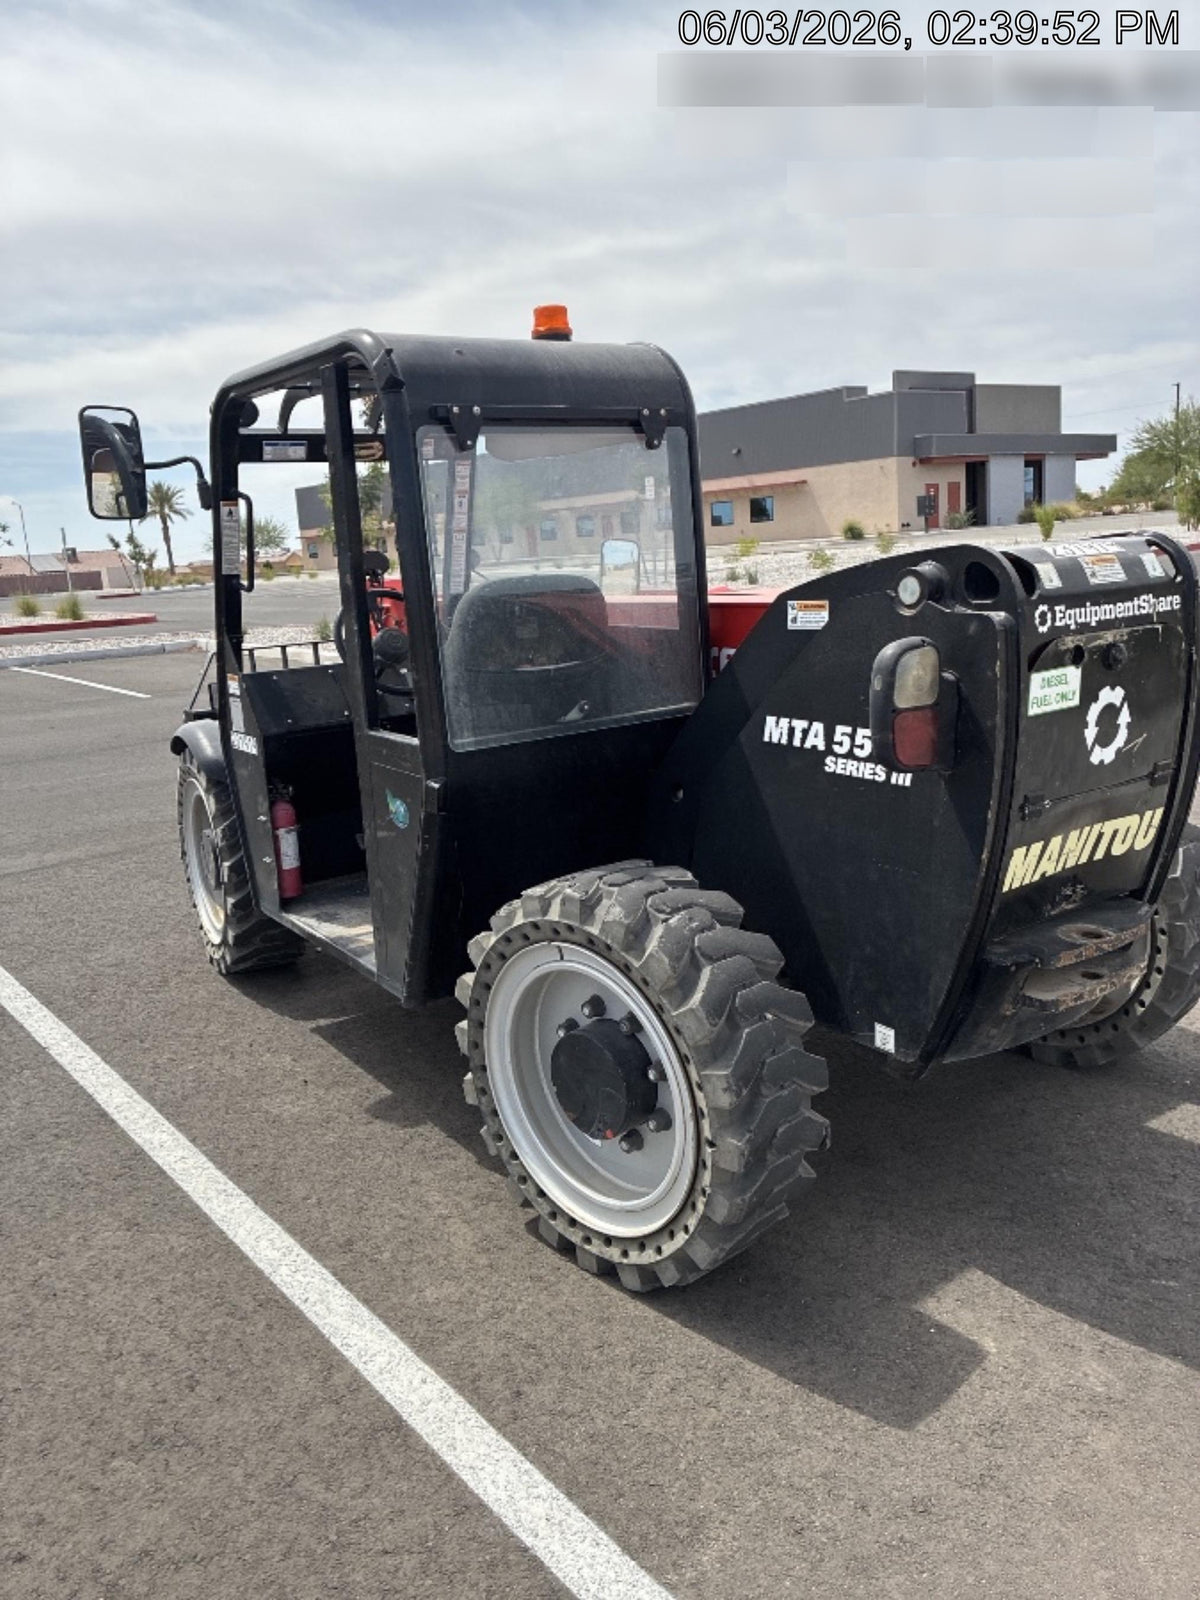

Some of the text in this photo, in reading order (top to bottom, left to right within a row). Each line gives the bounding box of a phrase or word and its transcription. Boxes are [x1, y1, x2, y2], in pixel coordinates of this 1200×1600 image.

[1053, 593, 1181, 630] EquipmentShare
[763, 715, 872, 759] MTA 55
[823, 755, 913, 787] SERIES III
[1002, 806, 1165, 893] MANITOU
